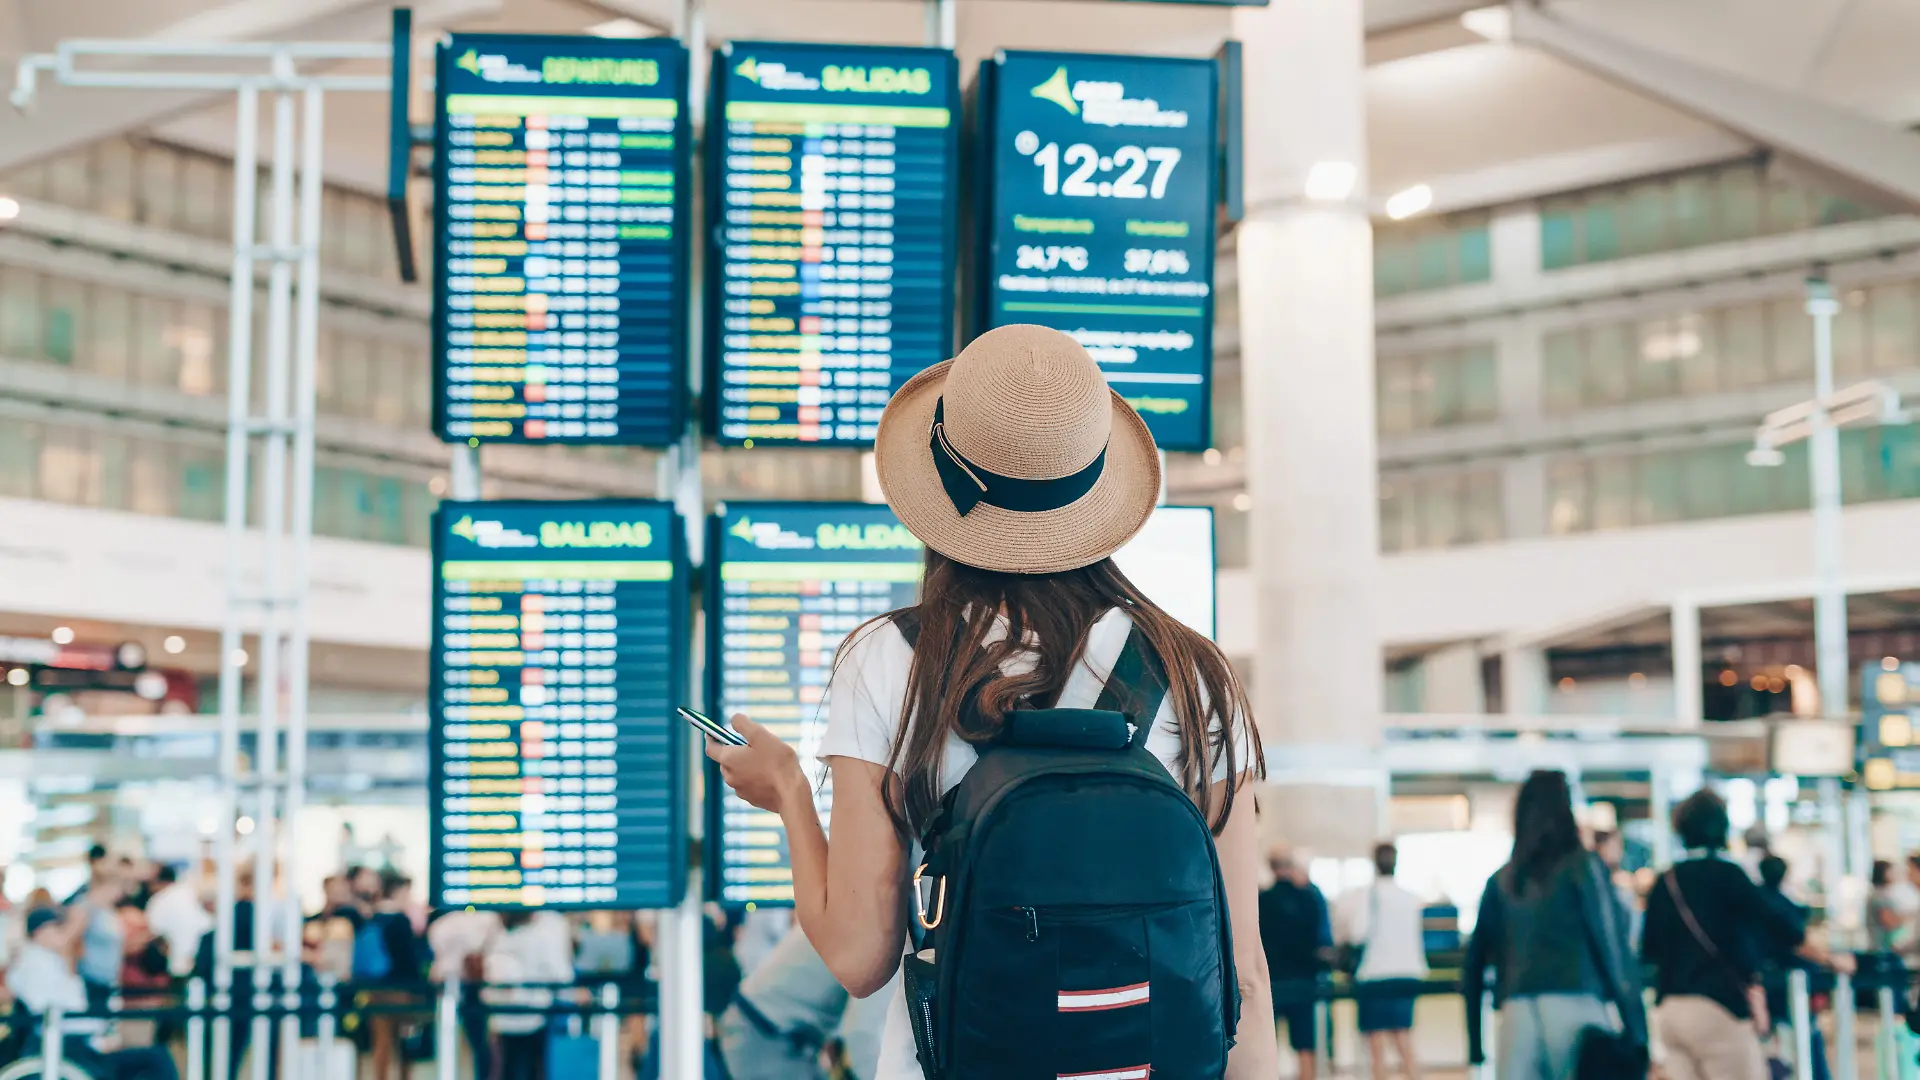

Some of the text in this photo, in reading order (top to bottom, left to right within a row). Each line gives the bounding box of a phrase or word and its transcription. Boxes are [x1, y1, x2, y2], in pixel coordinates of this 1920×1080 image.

[543, 57, 659, 85] DEPARTURES
[822, 65, 931, 94] SALIDAS
[1034, 142, 1181, 199] 12:27
[540, 521, 652, 548] SALIDAS
